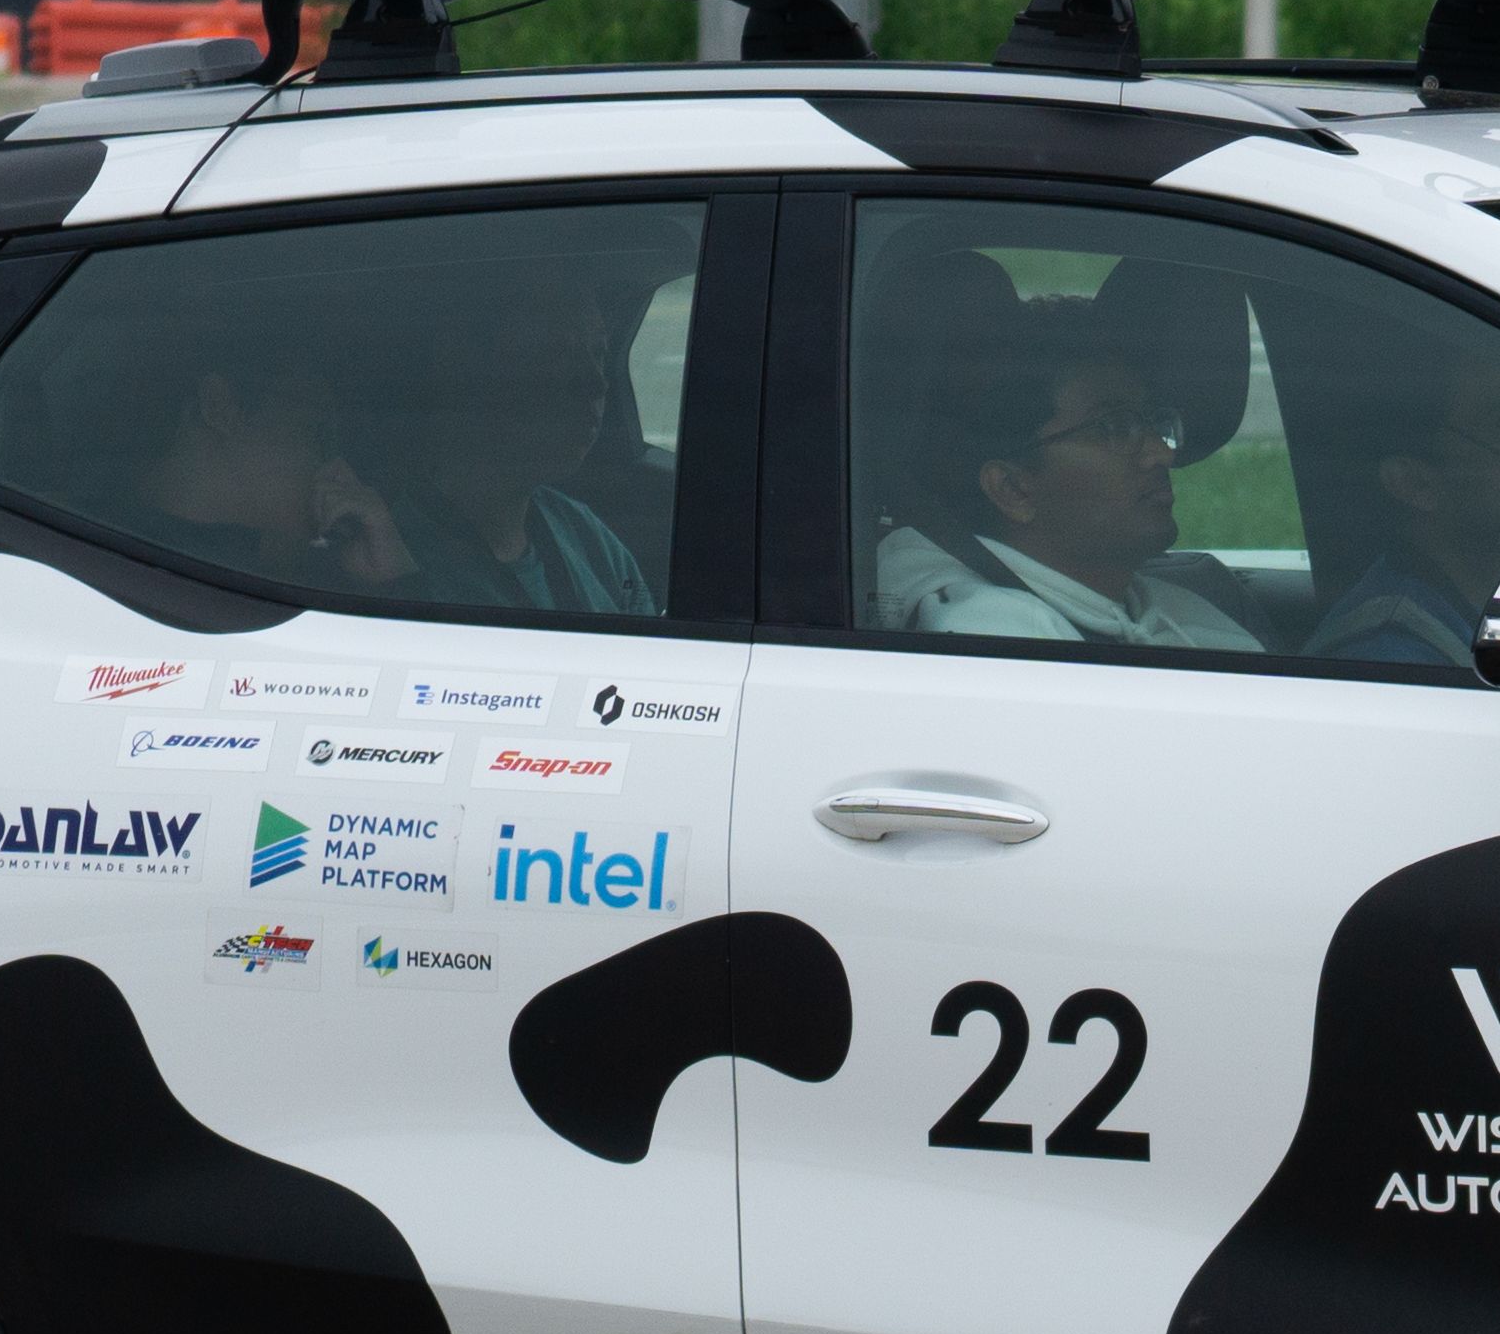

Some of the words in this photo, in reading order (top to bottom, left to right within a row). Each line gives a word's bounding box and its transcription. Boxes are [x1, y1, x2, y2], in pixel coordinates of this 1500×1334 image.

[87, 662, 186, 692] Milwaukee
[264, 682, 370, 698] WOODWARD
[441, 688, 542, 711] Instagantt
[631, 702, 721, 722] OSHKOSH
[162, 734, 261, 750] BOEING
[337, 746, 444, 765] MERCURY
[489, 750, 613, 777] Snap-on
[327, 814, 438, 839] DYNAMIC
[325, 841, 376, 861] MAP
[82, 862, 126, 873] MADE
[136, 864, 191, 875] SMART
[493, 824, 669, 911] intel
[322, 866, 448, 894] PLATFORM
[406, 951, 492, 970] HEXAGON
[928, 980, 1151, 1162] 22
